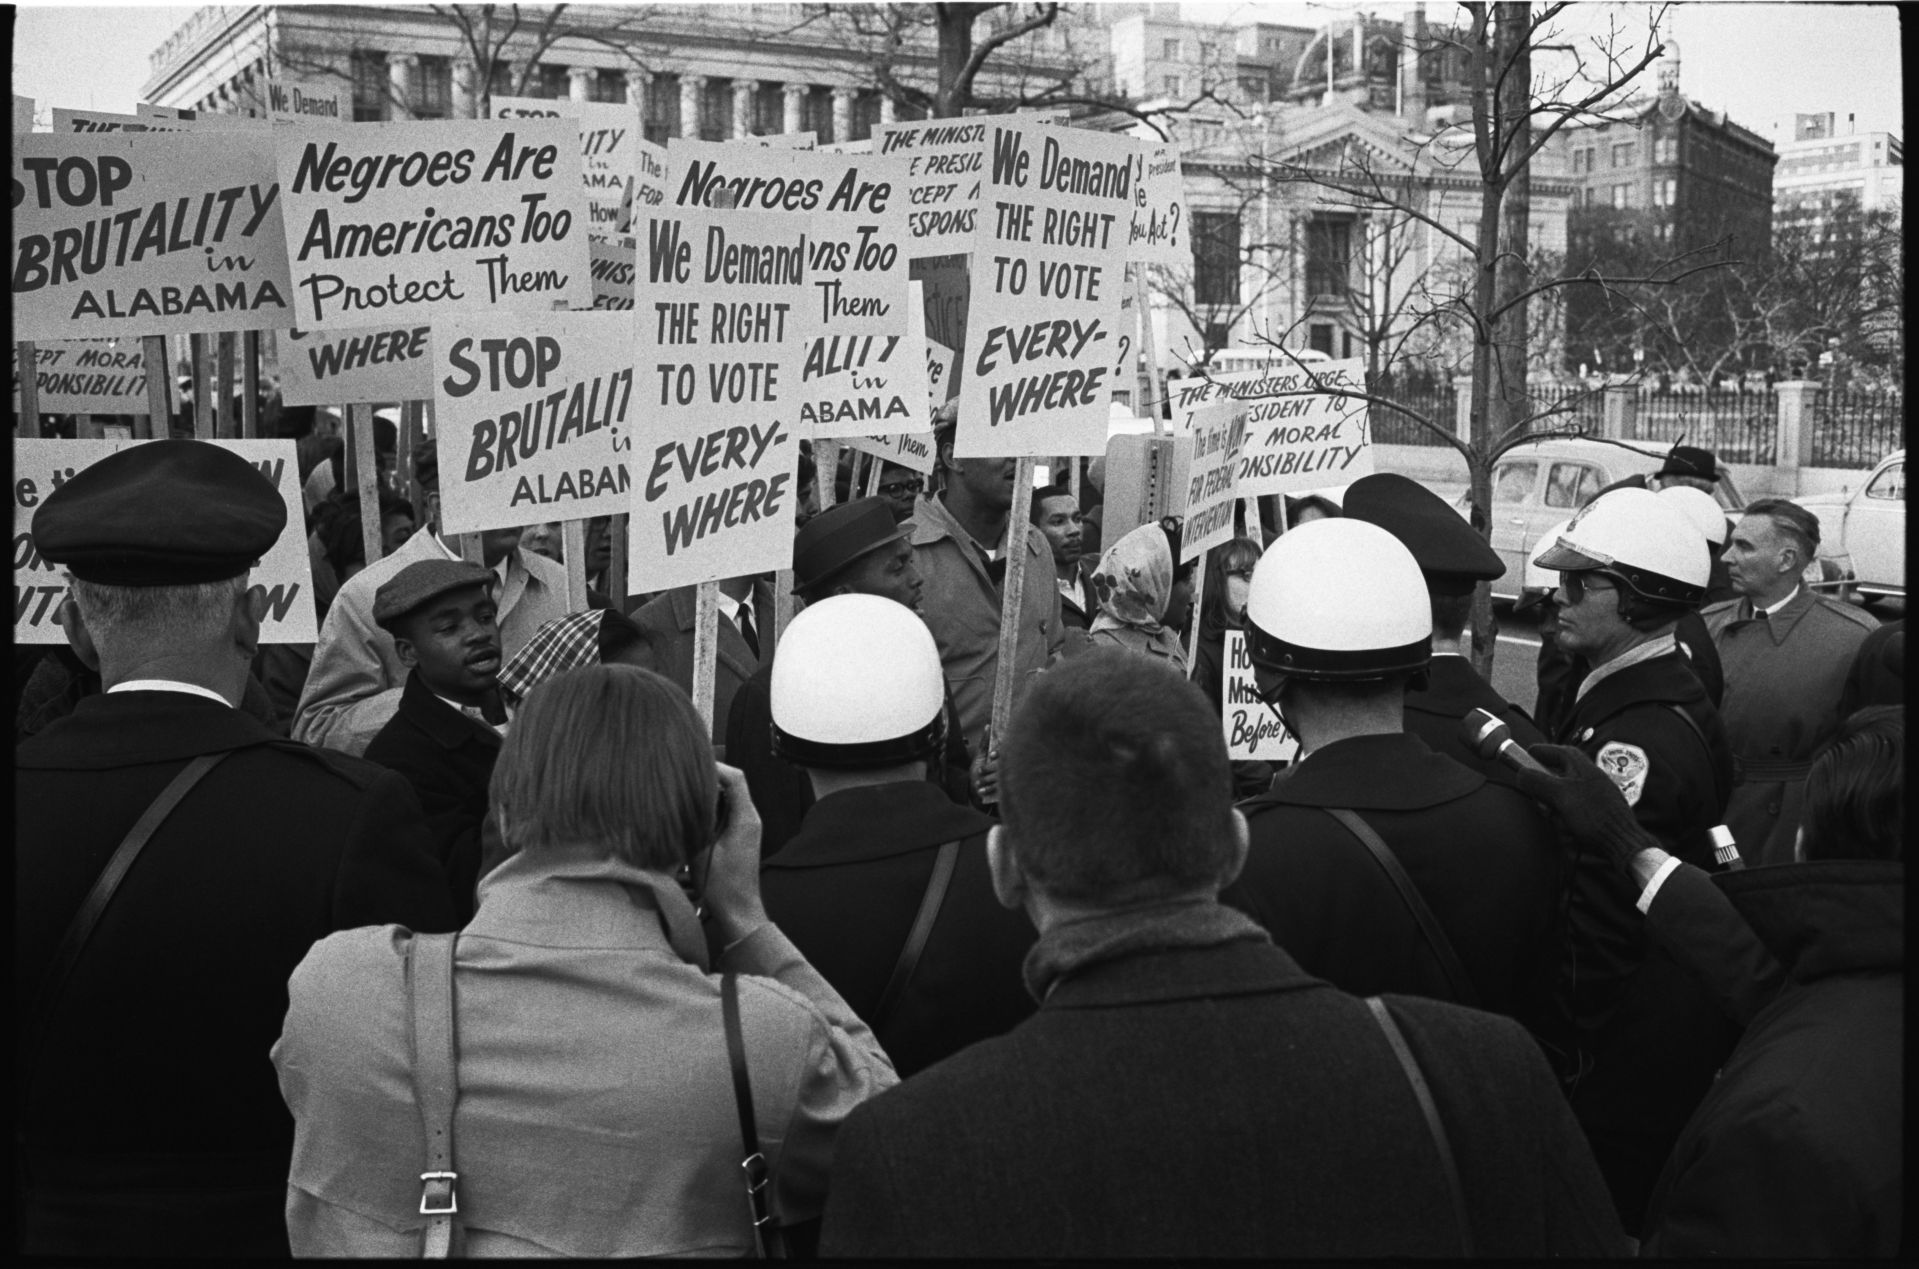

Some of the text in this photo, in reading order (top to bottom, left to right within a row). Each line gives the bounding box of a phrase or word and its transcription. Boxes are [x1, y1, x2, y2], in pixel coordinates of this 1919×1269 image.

[269, 84, 338, 117] We Demand
[641, 150, 662, 178] The
[882, 129, 920, 155] THE
[992, 128, 1030, 188] We
[1040, 136, 1133, 200] Demand
[292, 133, 558, 203] Negroes Are
[826, 167, 892, 214] Are
[589, 202, 619, 222] How
[636, 184, 664, 206] FOR
[910, 184, 958, 204] CEPT
[12, 183, 280, 293] BRUTALITY
[297, 192, 572, 262] Americans Too
[996, 201, 1116, 250] THE RIGHT
[205, 247, 257, 273] in
[649, 218, 806, 285] We Demand
[853, 226, 899, 271] Too
[71, 280, 287, 319] ALABAMA
[299, 254, 569, 321] Protect Them
[815, 278, 890, 323] Them
[994, 255, 1103, 301] TO VOTE
[655, 302, 791, 345] THE RIGHT
[76, 350, 146, 369] MORA
[308, 325, 432, 380] WHERE
[442, 336, 561, 397] STOP
[976, 318, 1108, 376] EVERY-
[657, 362, 779, 405] TO VOTE
[851, 371, 888, 390] in
[989, 367, 1108, 427] WHERE
[1179, 383, 1213, 408] THE
[1215, 374, 1299, 399] MINISTERS
[1324, 396, 1348, 413] TO
[1194, 428, 1207, 460] The
[1264, 424, 1342, 446] MORAL
[645, 420, 788, 502] EVERY-
[1187, 462, 1236, 508] FOR FEDERAL
[663, 473, 791, 556] WHERE
[1181, 498, 1235, 550] INTERVENTION
[1230, 709, 1281, 754] Before
